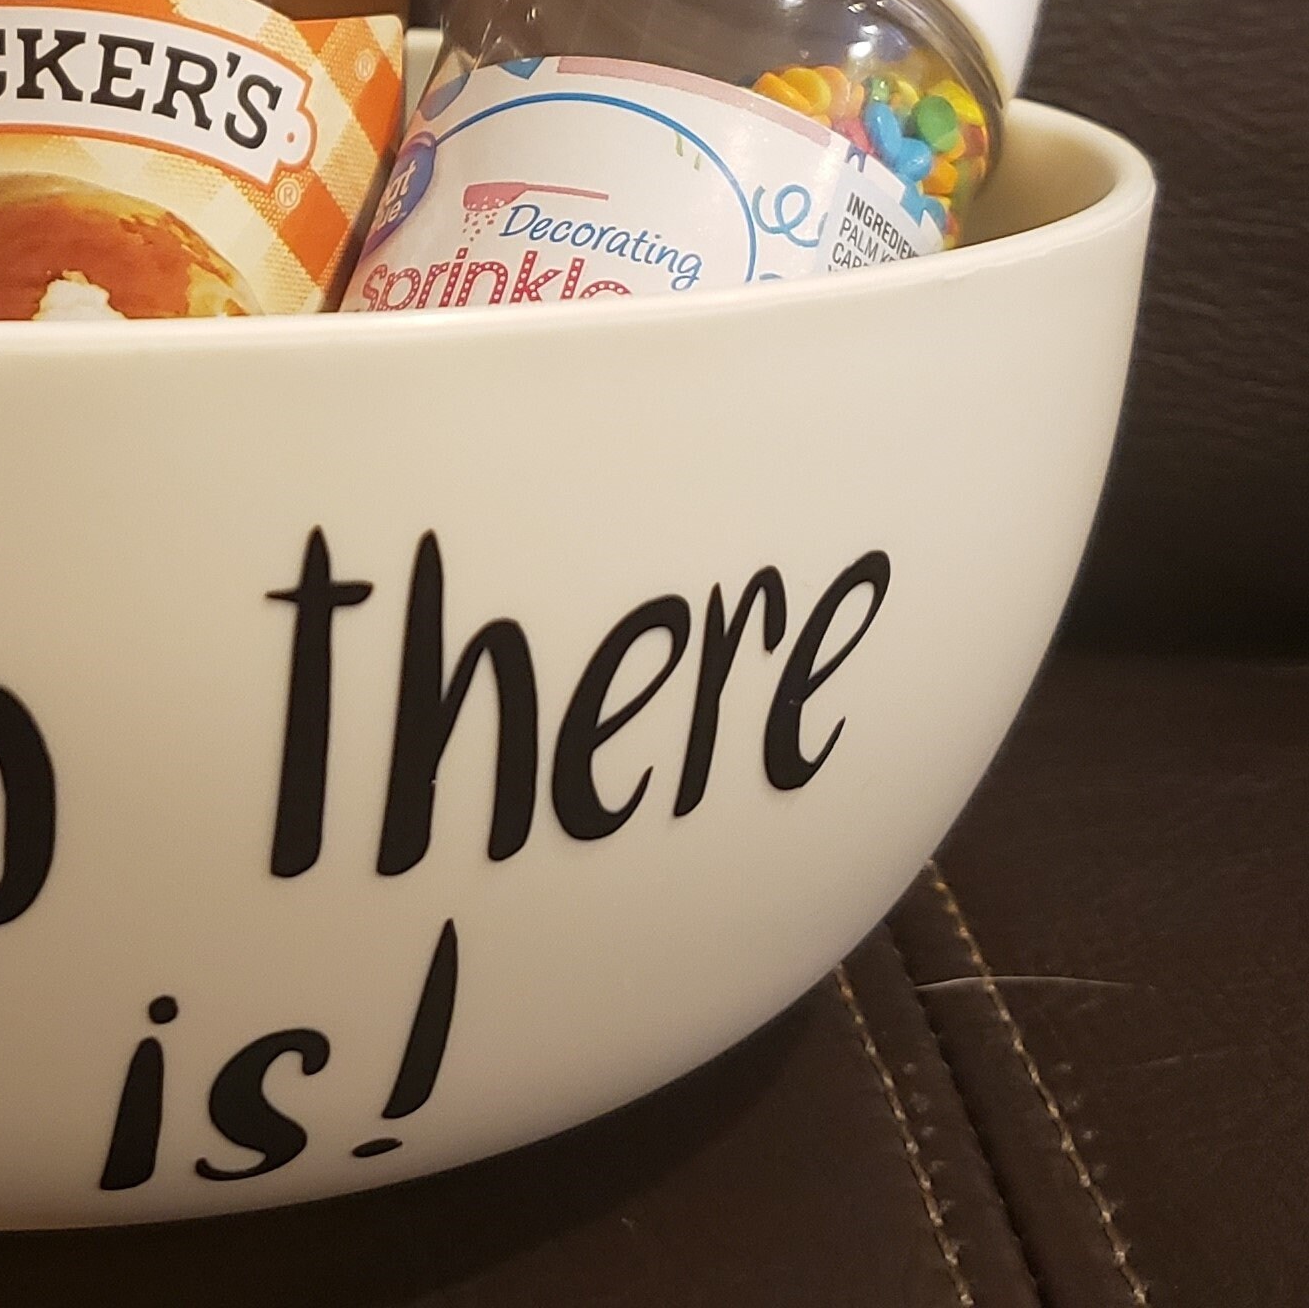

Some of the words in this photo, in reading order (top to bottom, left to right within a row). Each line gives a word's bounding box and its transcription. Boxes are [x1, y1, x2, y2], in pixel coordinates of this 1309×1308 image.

[498, 203, 704, 292] Decorating
[838, 216, 880, 262] PALM
[265, 526, 892, 880] there
[96, 917, 460, 1192] is!
